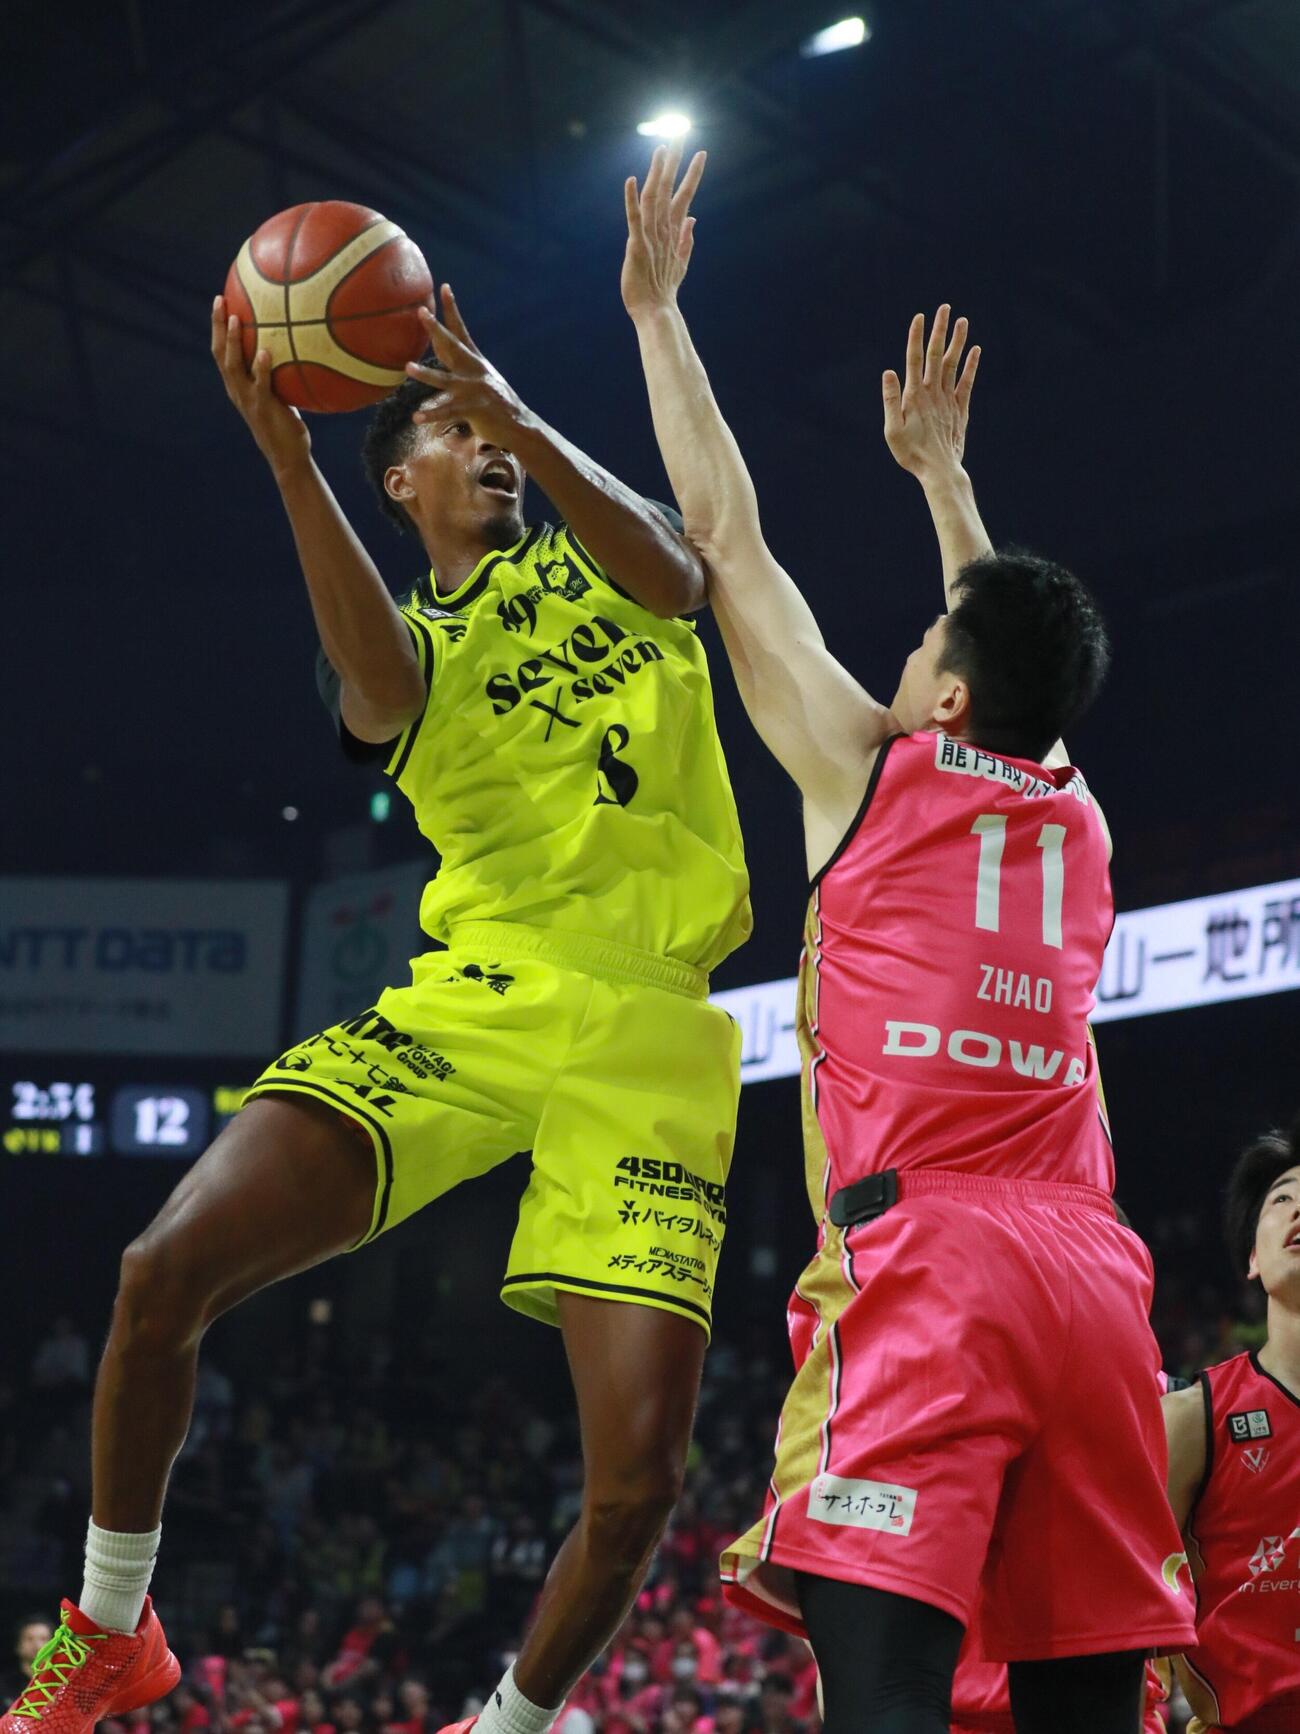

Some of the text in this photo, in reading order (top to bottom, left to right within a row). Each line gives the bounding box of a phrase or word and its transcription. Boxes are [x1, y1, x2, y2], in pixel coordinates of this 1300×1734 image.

[571, 638, 665, 704] seven
[971, 813, 1067, 951] 11
[976, 963, 1053, 1014] ZHAO
[397, 1052, 428, 1080] Group
[135, 1097, 190, 1144] 12
